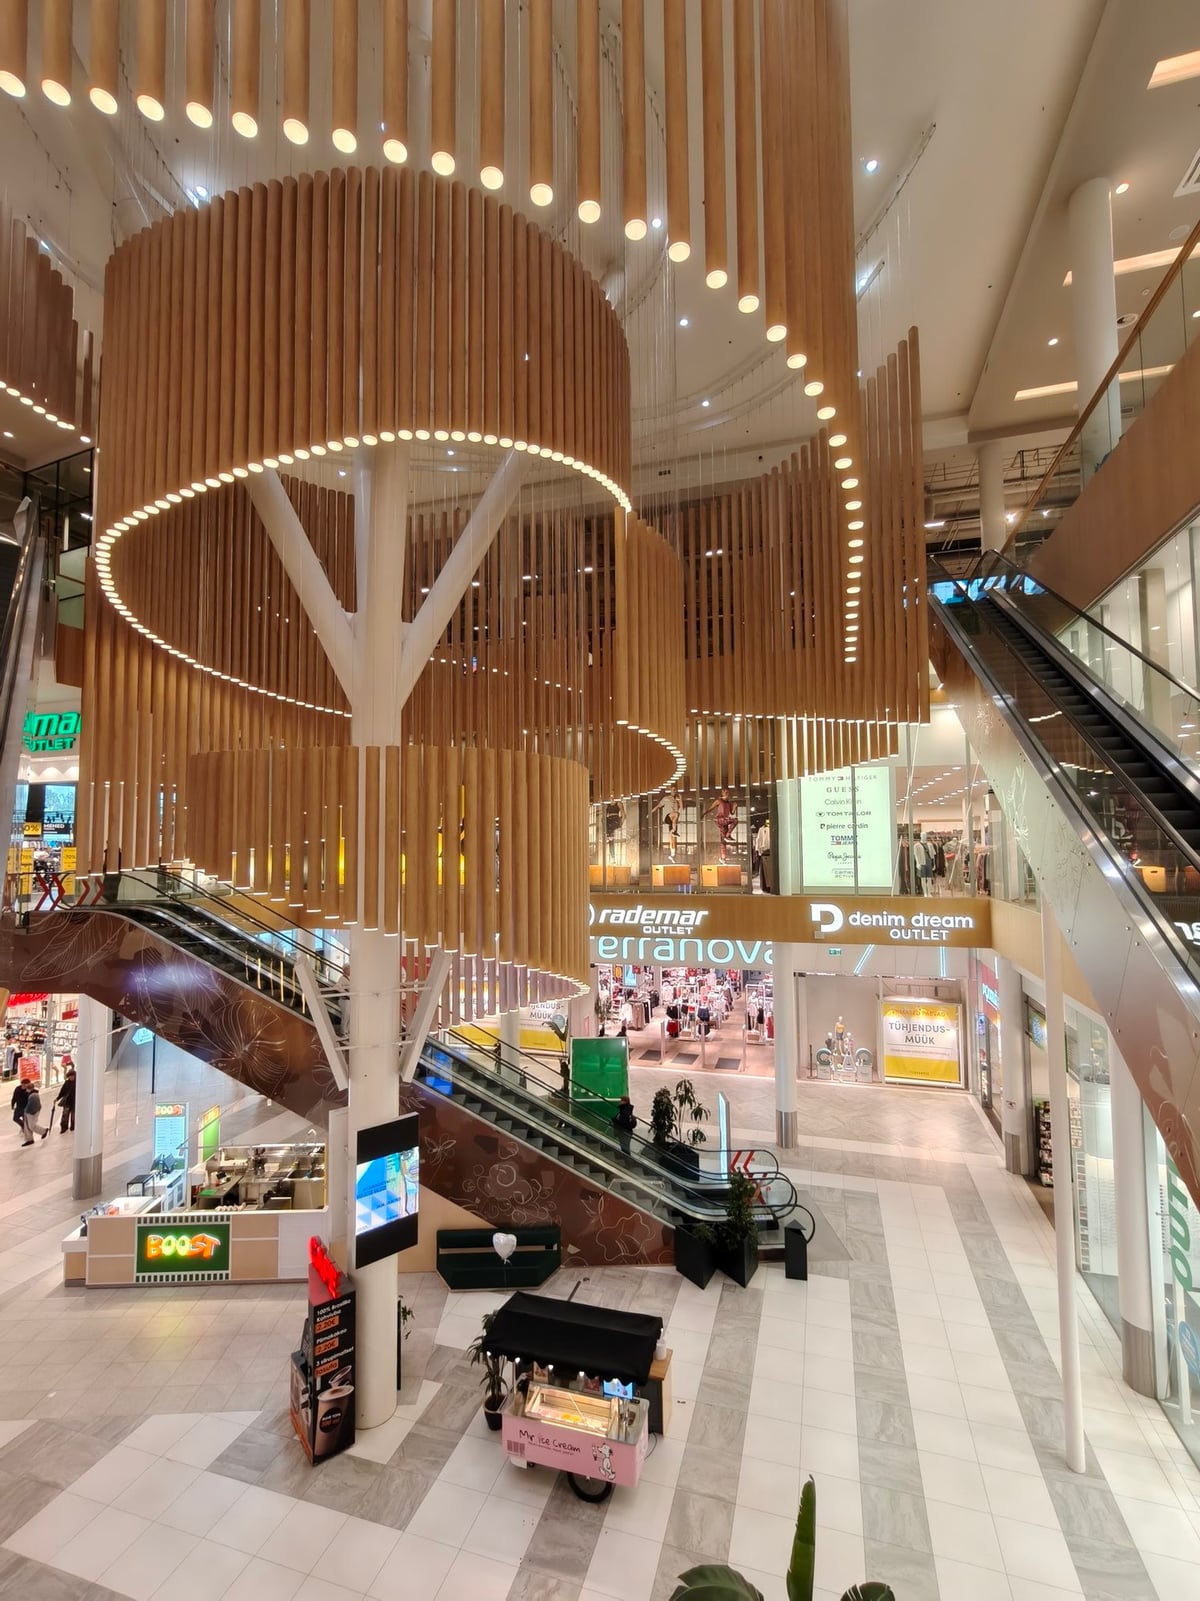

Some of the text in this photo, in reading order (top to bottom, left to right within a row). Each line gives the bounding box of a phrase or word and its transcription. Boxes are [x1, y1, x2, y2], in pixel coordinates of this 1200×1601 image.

[826, 823, 845, 831] pierre
[598, 905, 709, 925] rademar
[848, 911, 905, 927] denim
[911, 912, 974, 929] dream
[642, 925, 694, 935] OUTLET
[889, 928, 950, 941] OUTLET
[590, 935, 773, 965] erranov
[889, 1020, 951, 1034] TÜHJENDUS-
[904, 1034, 935, 1045] MÜÜK
[146, 1233, 221, 1260] BOOST
